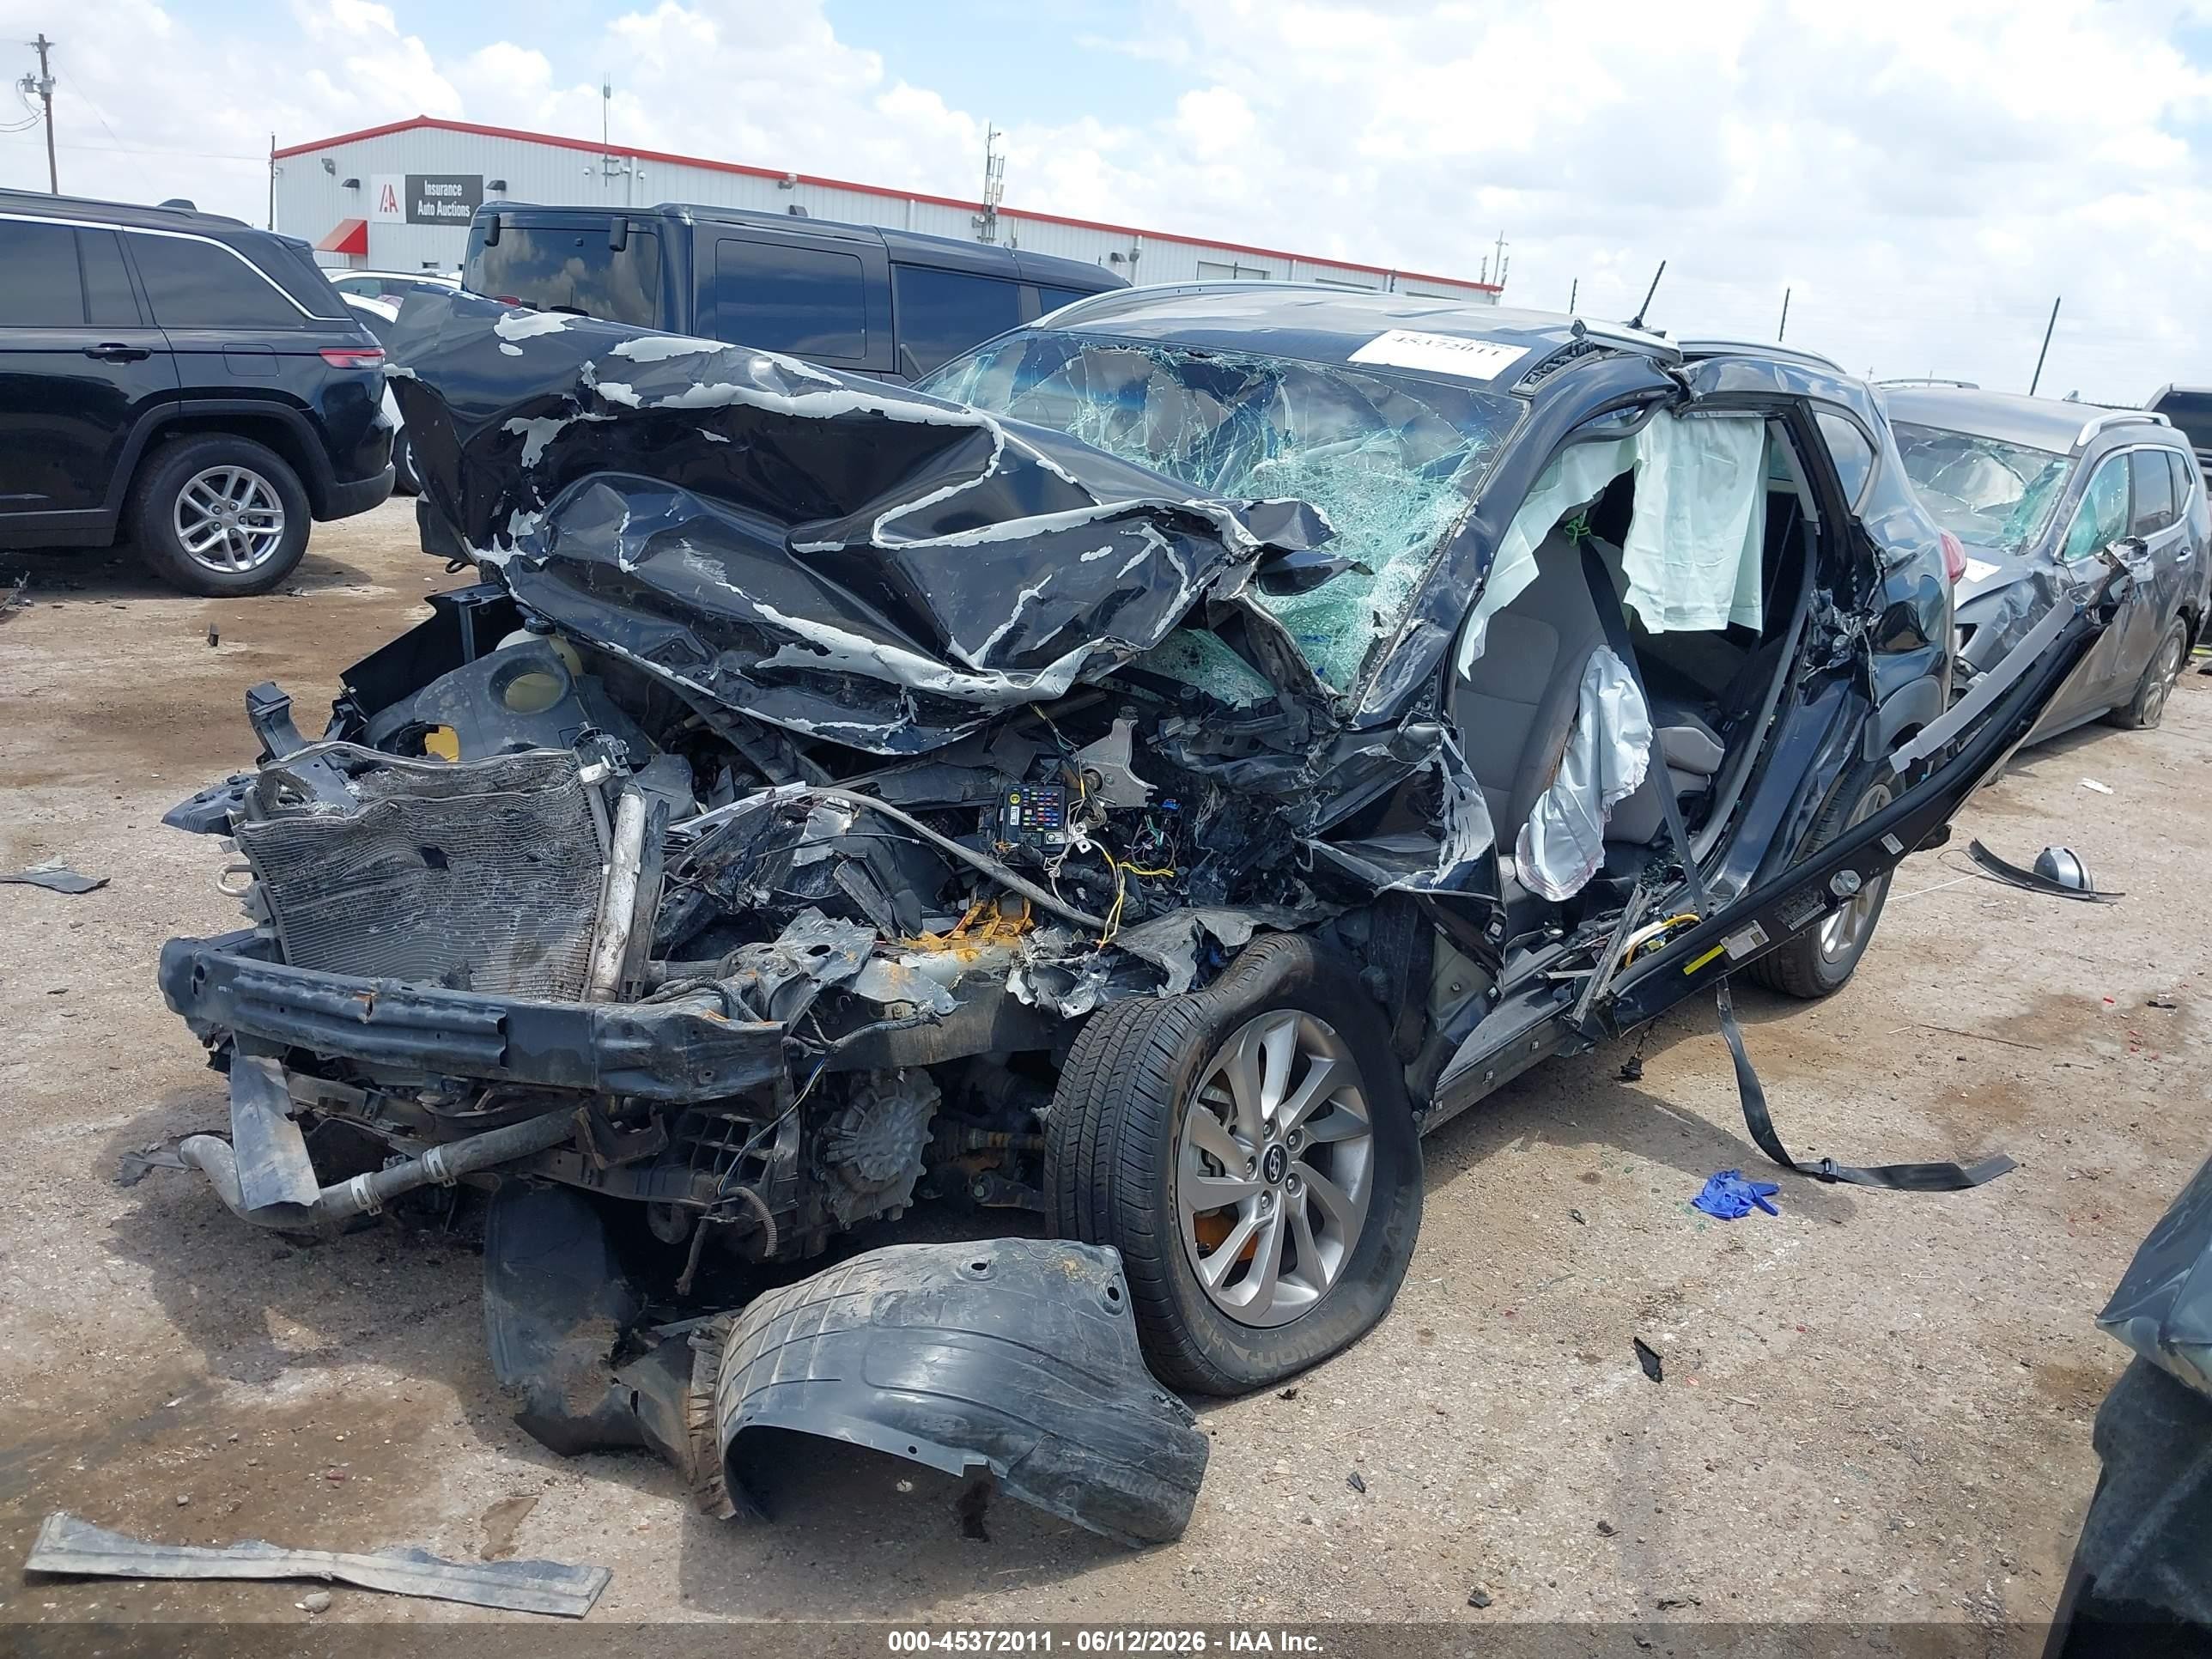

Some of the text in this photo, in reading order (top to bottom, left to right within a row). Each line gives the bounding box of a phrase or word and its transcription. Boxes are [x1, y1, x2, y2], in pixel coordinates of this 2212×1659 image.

[424, 179, 463, 197] Insurance
[417, 199, 471, 217] Auto Auctions
